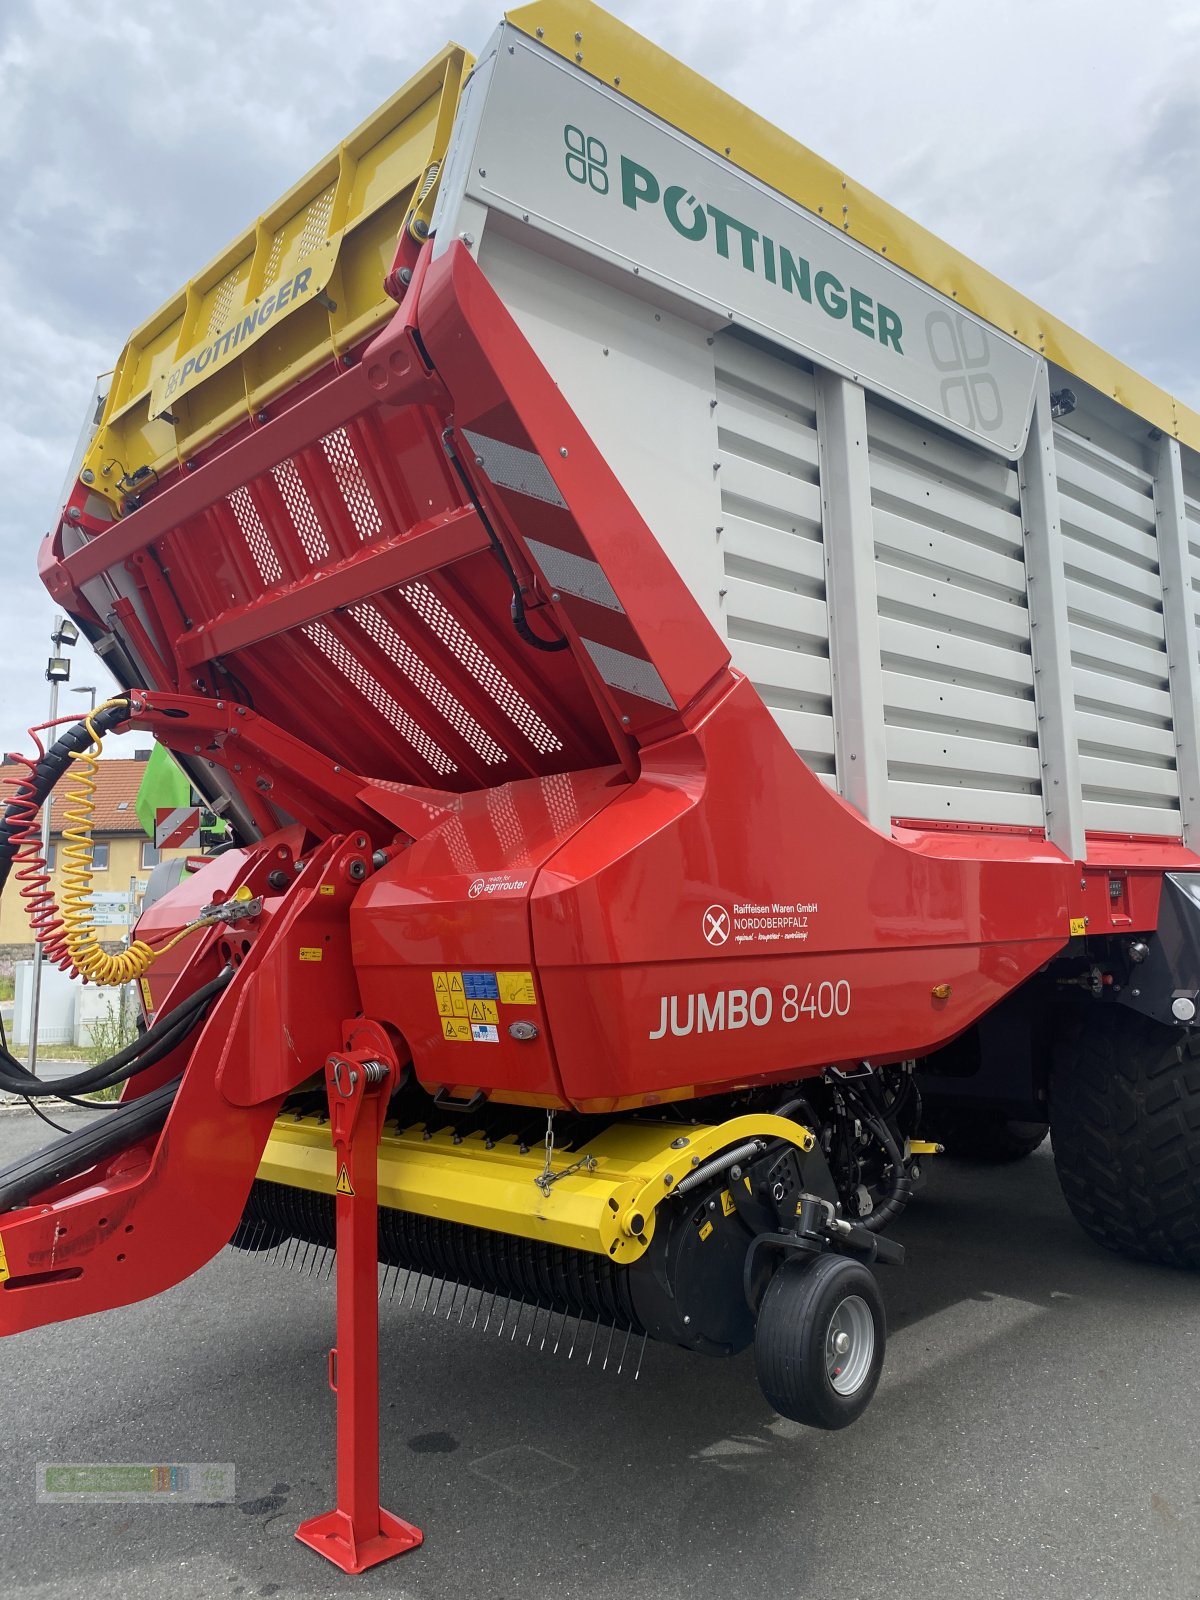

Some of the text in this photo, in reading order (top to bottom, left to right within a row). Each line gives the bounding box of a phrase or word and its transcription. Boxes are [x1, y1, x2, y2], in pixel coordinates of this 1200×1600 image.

[620, 154, 904, 356] PÖTTINGER
[484, 880, 527, 894] agrirouter
[733, 903, 818, 914] Raiffeisen Waren GmbH
[734, 916, 808, 930] NORDOBERPFALZ
[649, 979, 851, 1040] JUMBO 8400
